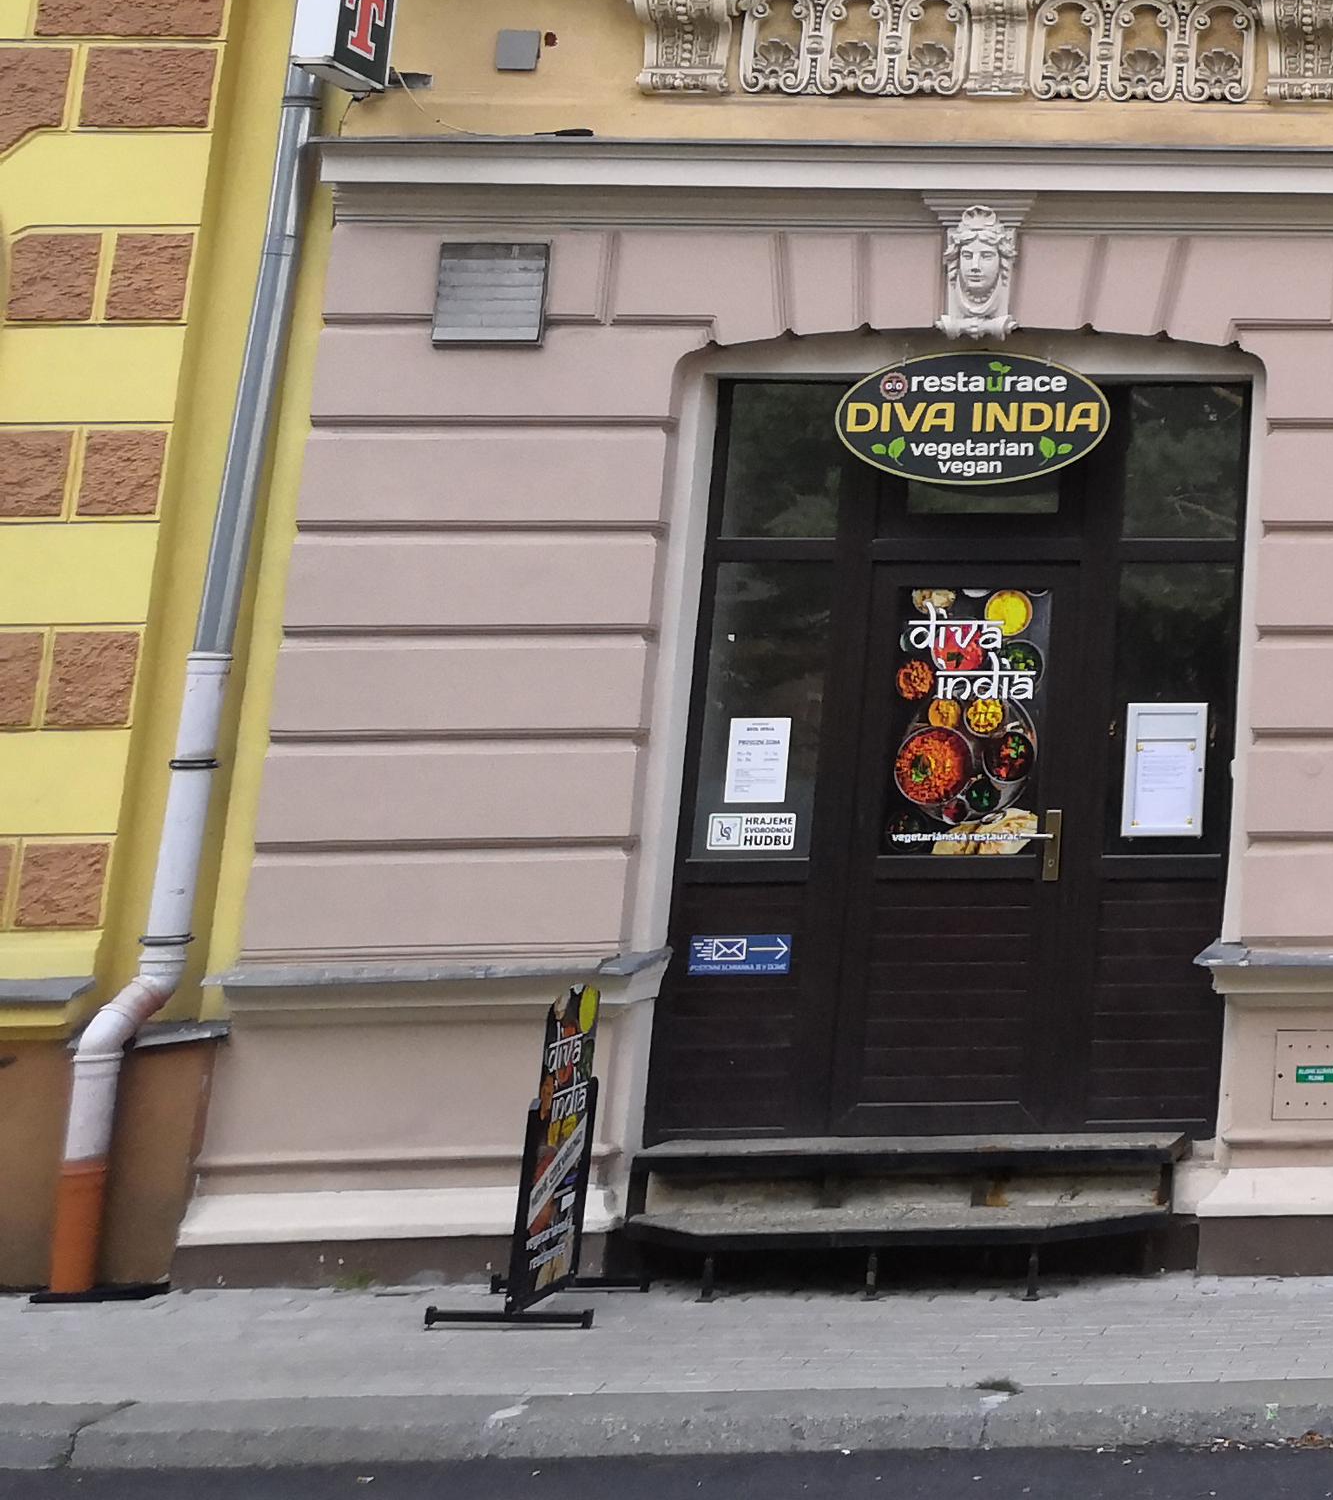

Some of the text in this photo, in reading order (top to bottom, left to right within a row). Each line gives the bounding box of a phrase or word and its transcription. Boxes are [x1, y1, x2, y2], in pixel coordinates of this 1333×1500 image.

[910, 367, 1068, 393] restaurace
[846, 402, 1100, 433] DIVA INDIA
[910, 438, 1034, 459] vegetarian
[938, 459, 1002, 477] vegan
[908, 601, 1005, 649] diva
[936, 652, 1037, 700] india
[745, 817, 793, 825] HRAJEME
[743, 835, 792, 846] HUDBU
